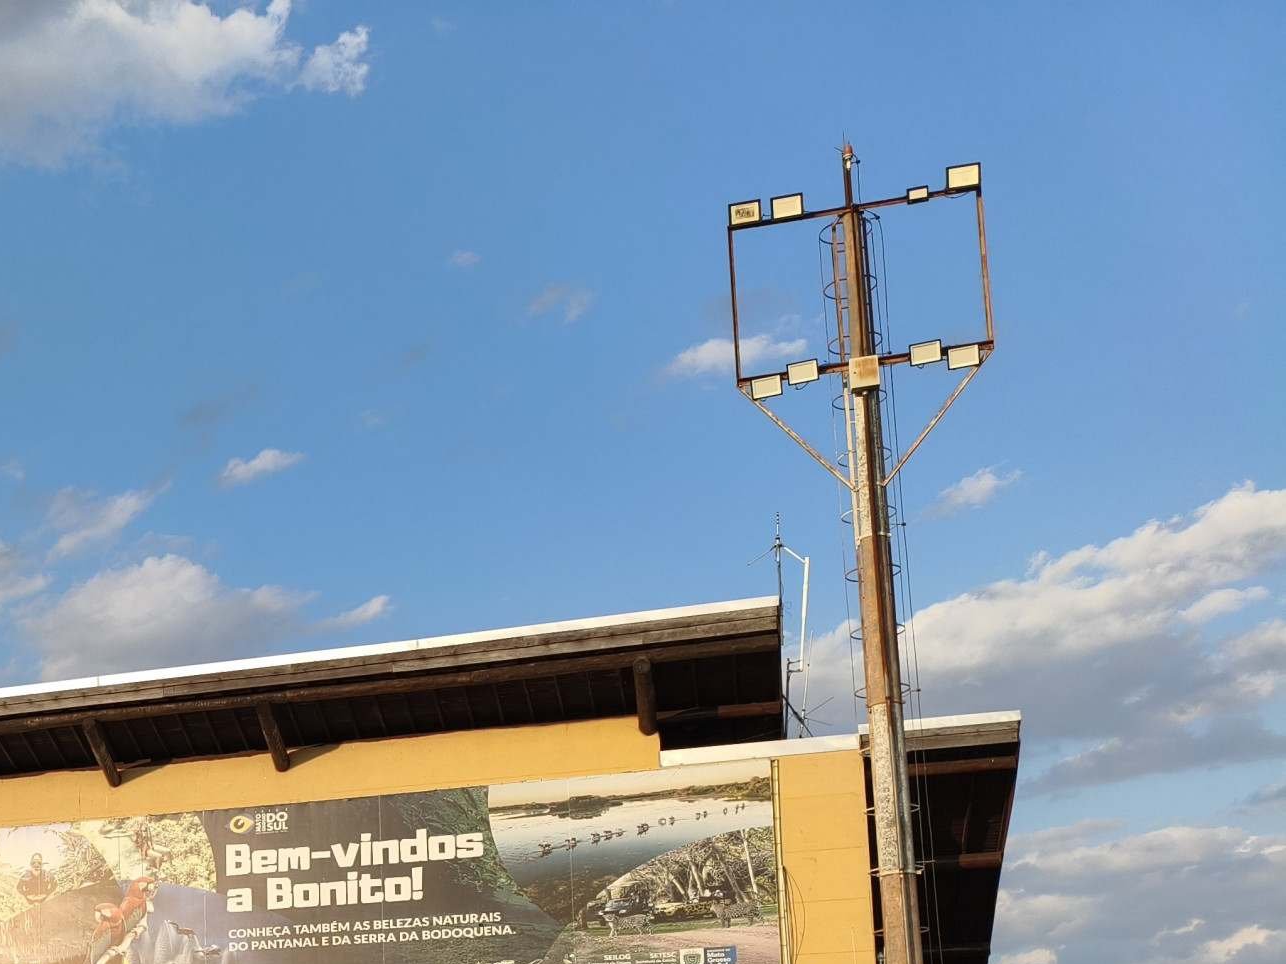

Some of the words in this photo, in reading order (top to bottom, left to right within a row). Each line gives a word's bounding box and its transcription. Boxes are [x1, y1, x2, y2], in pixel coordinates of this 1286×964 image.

[266, 811, 288, 823] DO
[266, 821, 289, 831] SUL
[225, 828, 484, 877] Bem-vindos
[226, 887, 253, 912] a
[266, 866, 424, 910] Bonito!
[228, 925, 291, 939] CONHEÇA
[293, 920, 350, 935] TAMBÉM
[353, 920, 371, 931] AS
[373, 916, 430, 930] BELEZAS
[432, 911, 502, 926] NATURAIS
[228, 941, 249, 951] DO
[251, 937, 320, 950] PANTANAL
[321, 936, 330, 946] E
[332, 935, 352, 946] DA
[353, 932, 397, 944] SERRA
[399, 931, 420, 942] DA
[422, 924, 517, 941] BODOQUENA.
[603, 953, 631, 961] SEILOG
